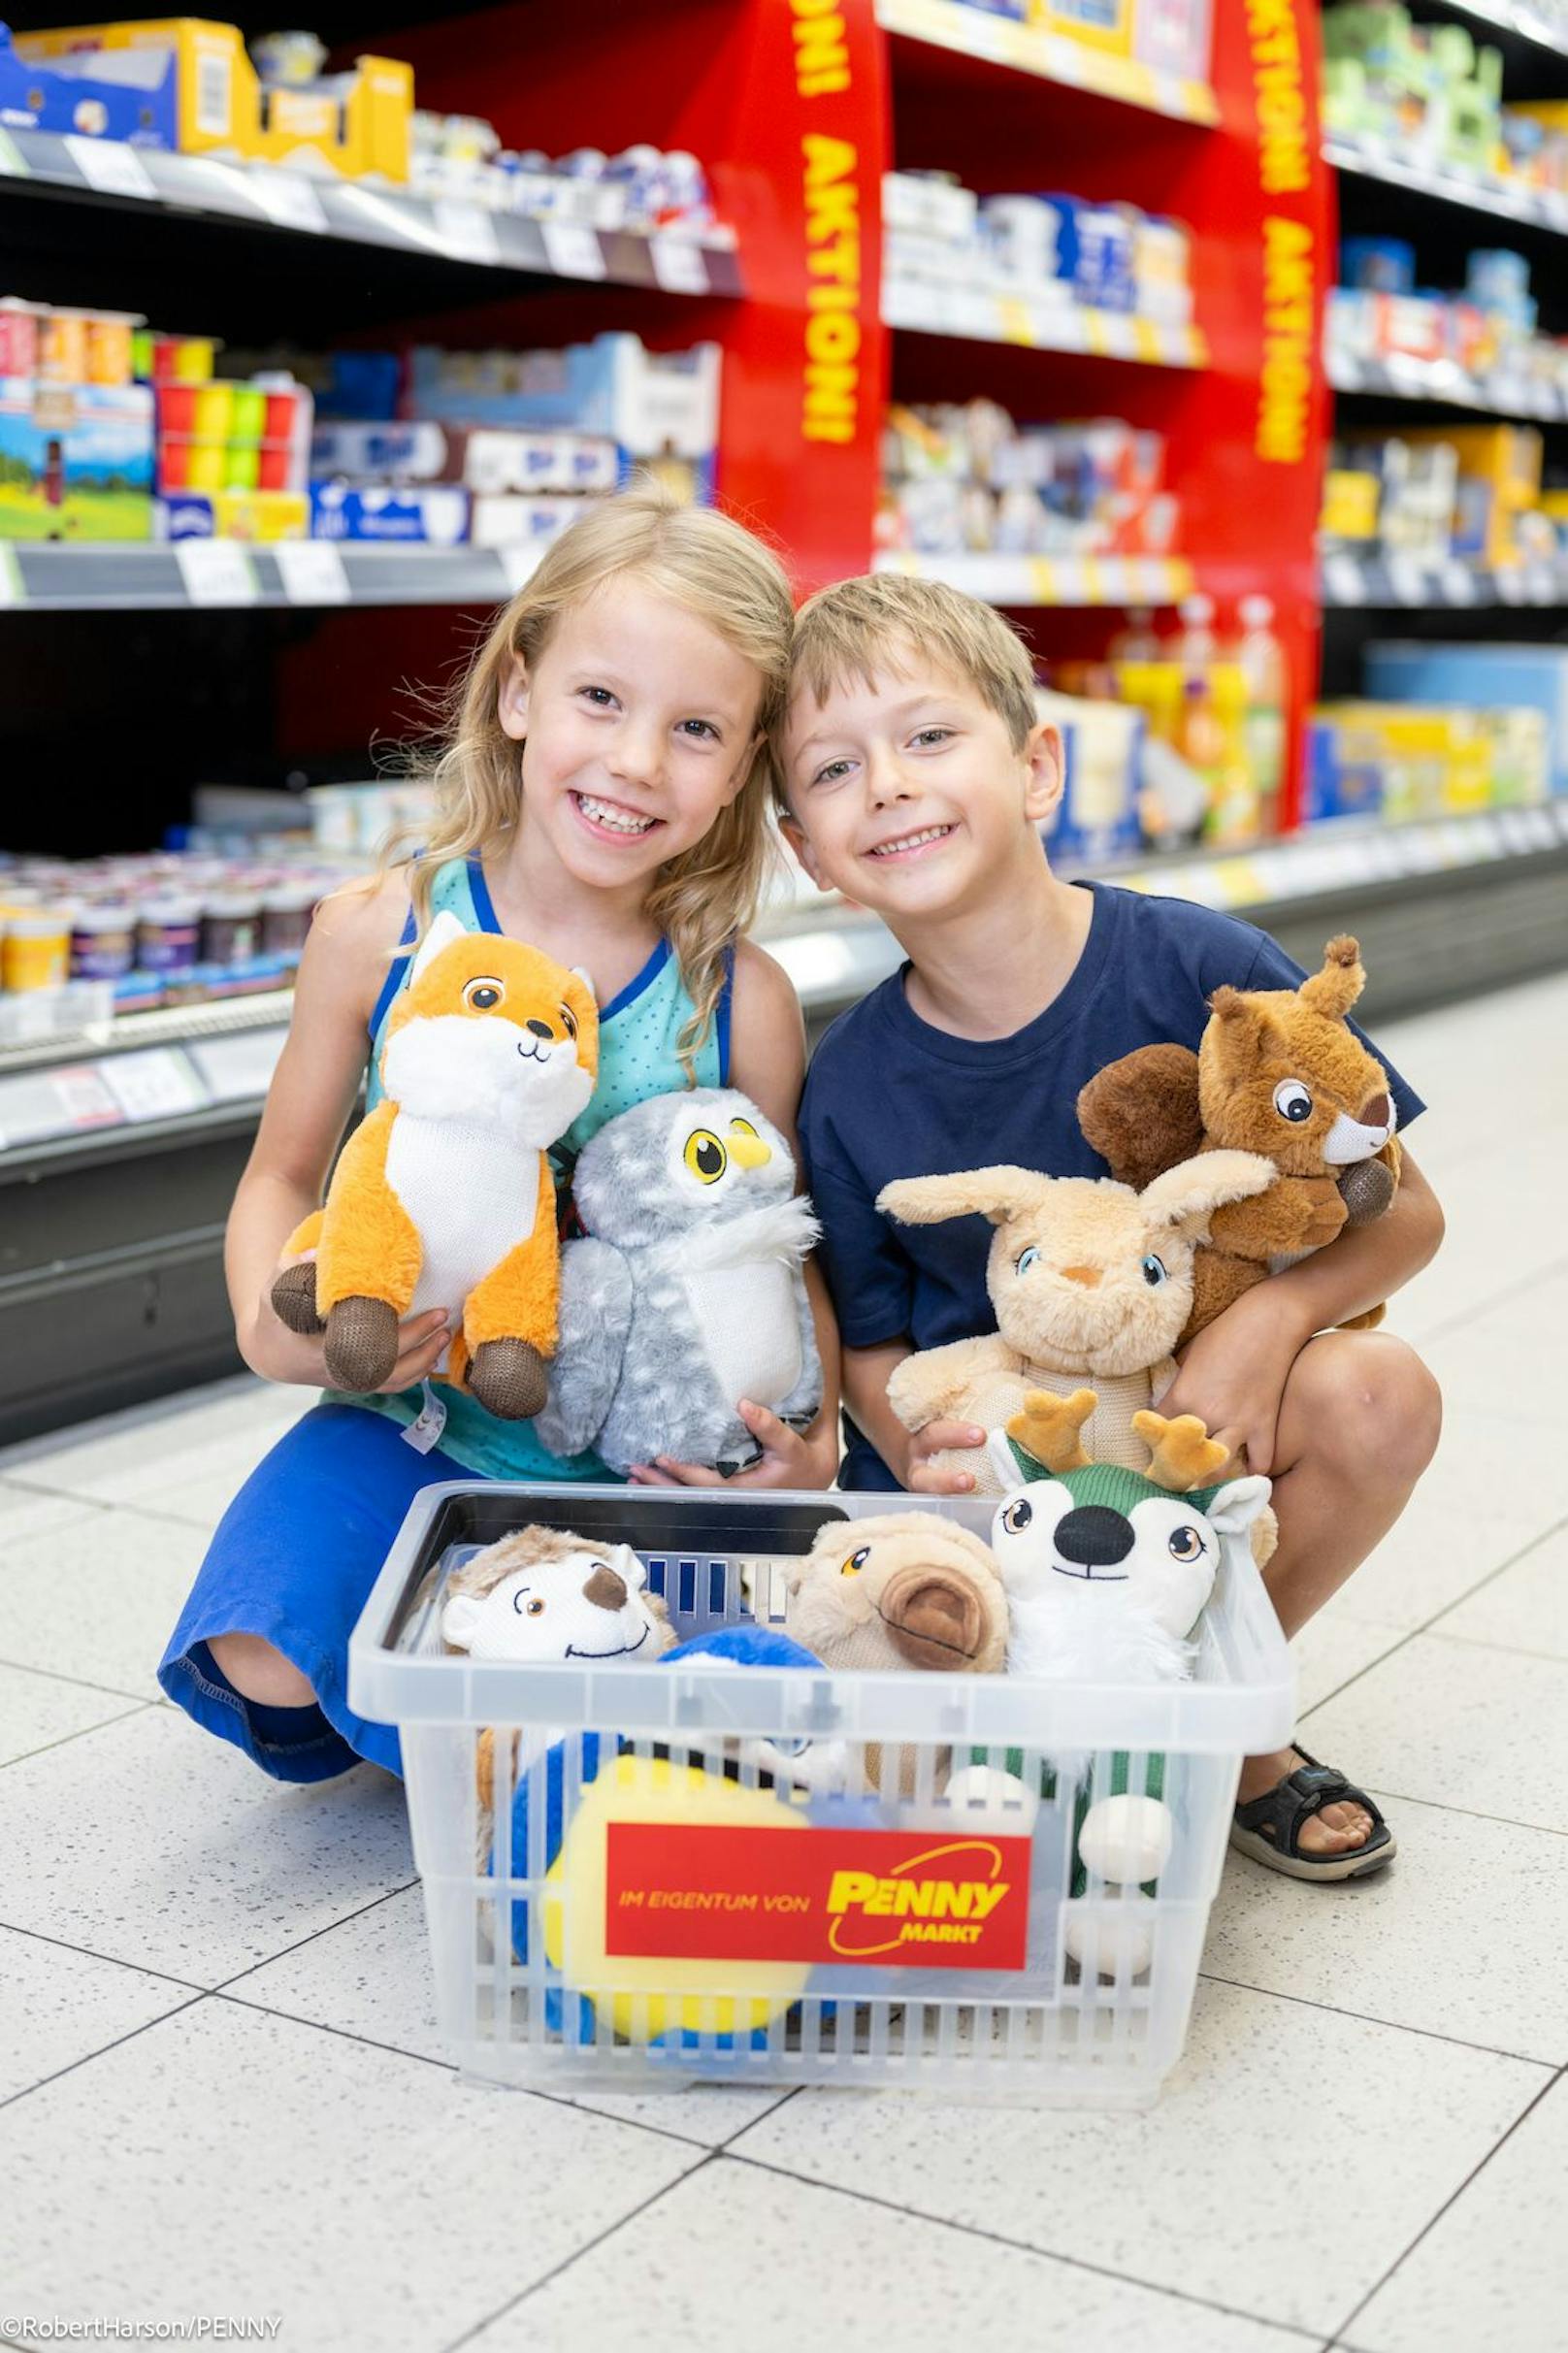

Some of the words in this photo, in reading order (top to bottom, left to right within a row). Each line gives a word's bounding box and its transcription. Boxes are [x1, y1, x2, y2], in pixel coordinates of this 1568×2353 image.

[619, 1890, 645, 1908] IM
[647, 1890, 758, 1911] EIGENTUM
[764, 1894, 810, 1912] VON
[827, 1870, 1010, 1919] PENNY
[899, 1922, 983, 1944] MARKT
